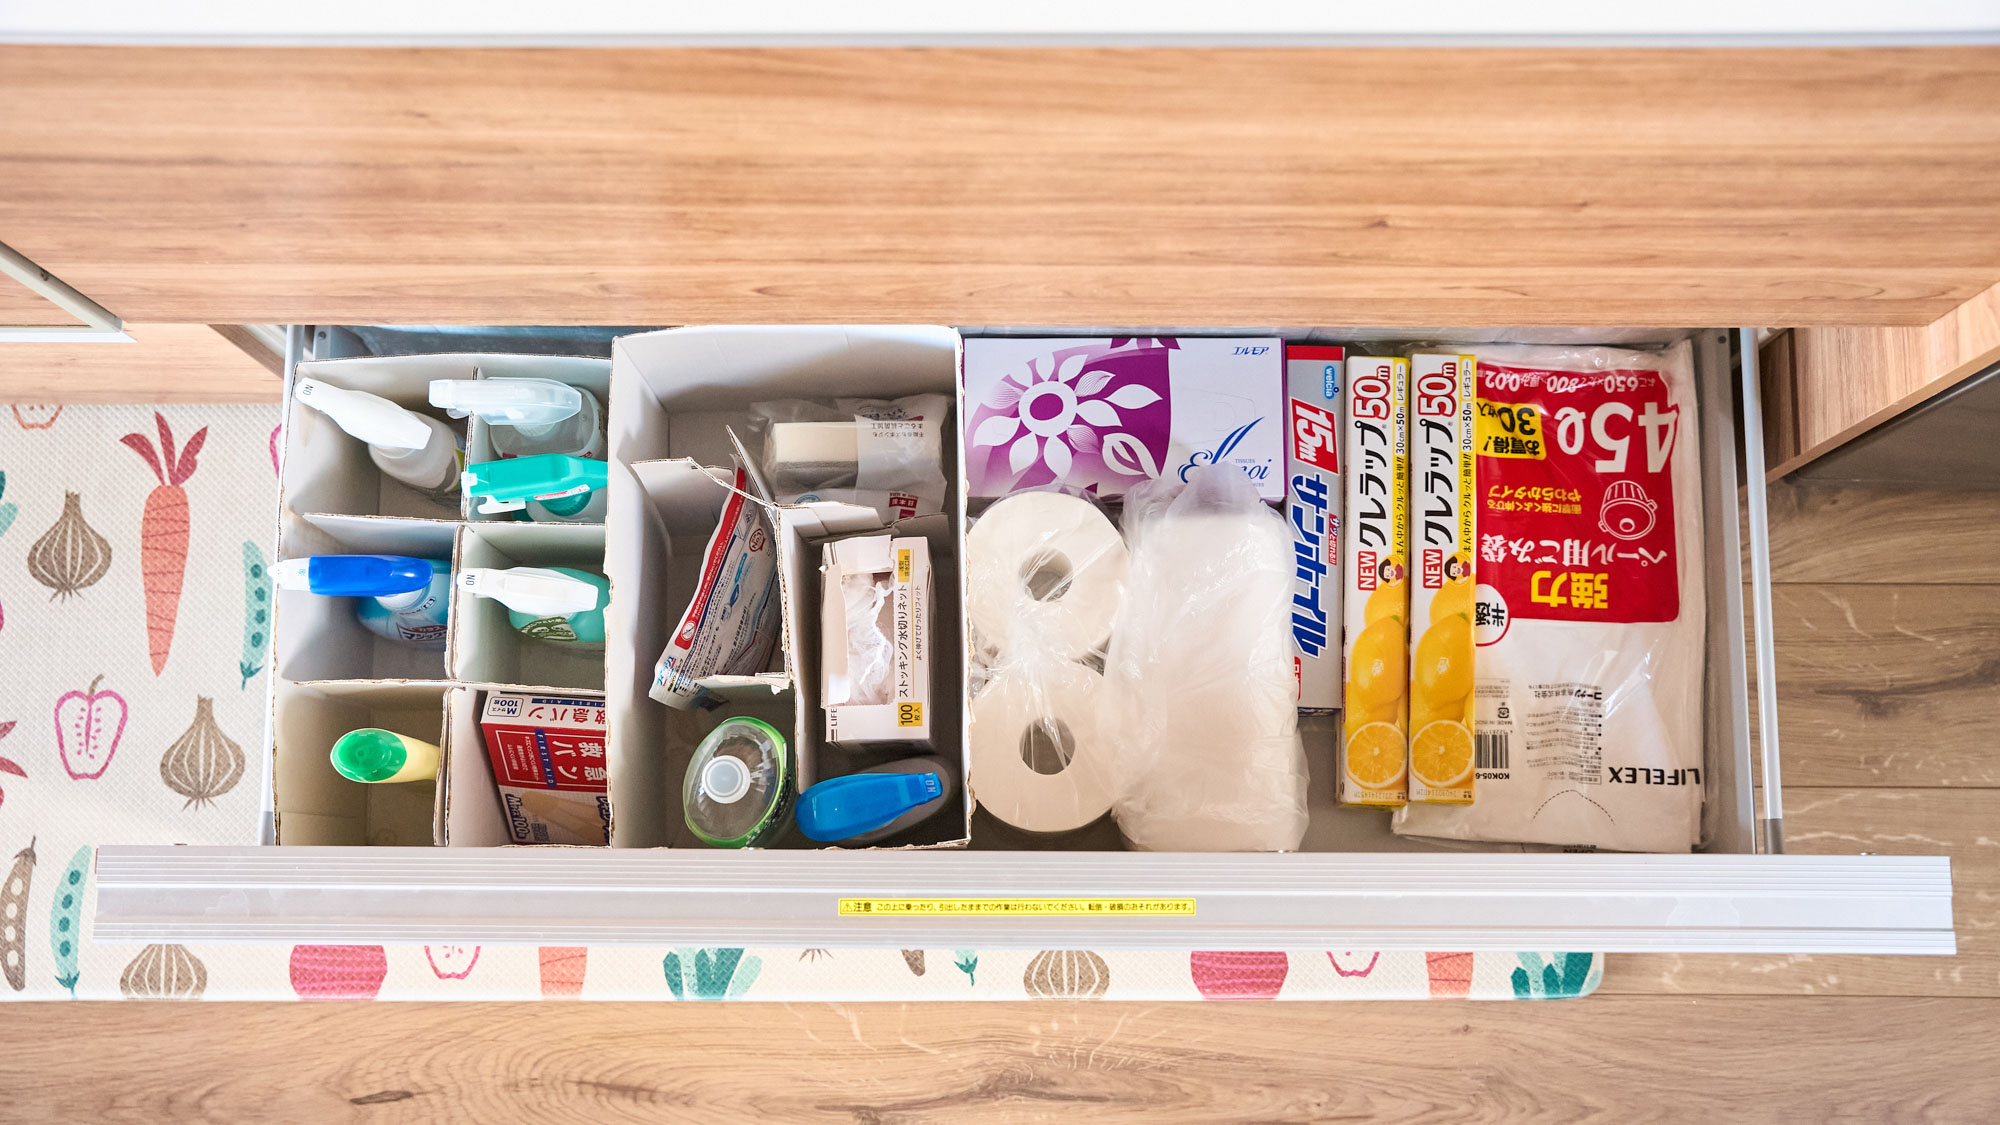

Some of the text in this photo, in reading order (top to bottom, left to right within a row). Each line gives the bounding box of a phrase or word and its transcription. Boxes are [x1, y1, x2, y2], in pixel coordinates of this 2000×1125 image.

[1232, 346, 1269, 356] エルモア
[302, 383, 314, 396] ON
[1325, 367, 1339, 398] welcia
[1294, 408, 1334, 462] 15m
[1353, 365, 1392, 589] NEW クレラップ 50m
[1418, 362, 1457, 588] NEW クレラップ 50m
[1488, 484, 1582, 502] やわらかタイプ
[1480, 533, 1668, 567] ペール用ごみ袋
[465, 573, 475, 586] ON
[1530, 570, 1609, 609] 強力
[897, 585, 909, 698] ストッキング水切りネット
[900, 705, 913, 725] 100
[913, 707, 921, 721] 枚入
[537, 734, 554, 783] FIRST AID
[552, 740, 578, 780] バン
[1609, 766, 1701, 785] LIFELEX
[852, 902, 872, 913] 注意
